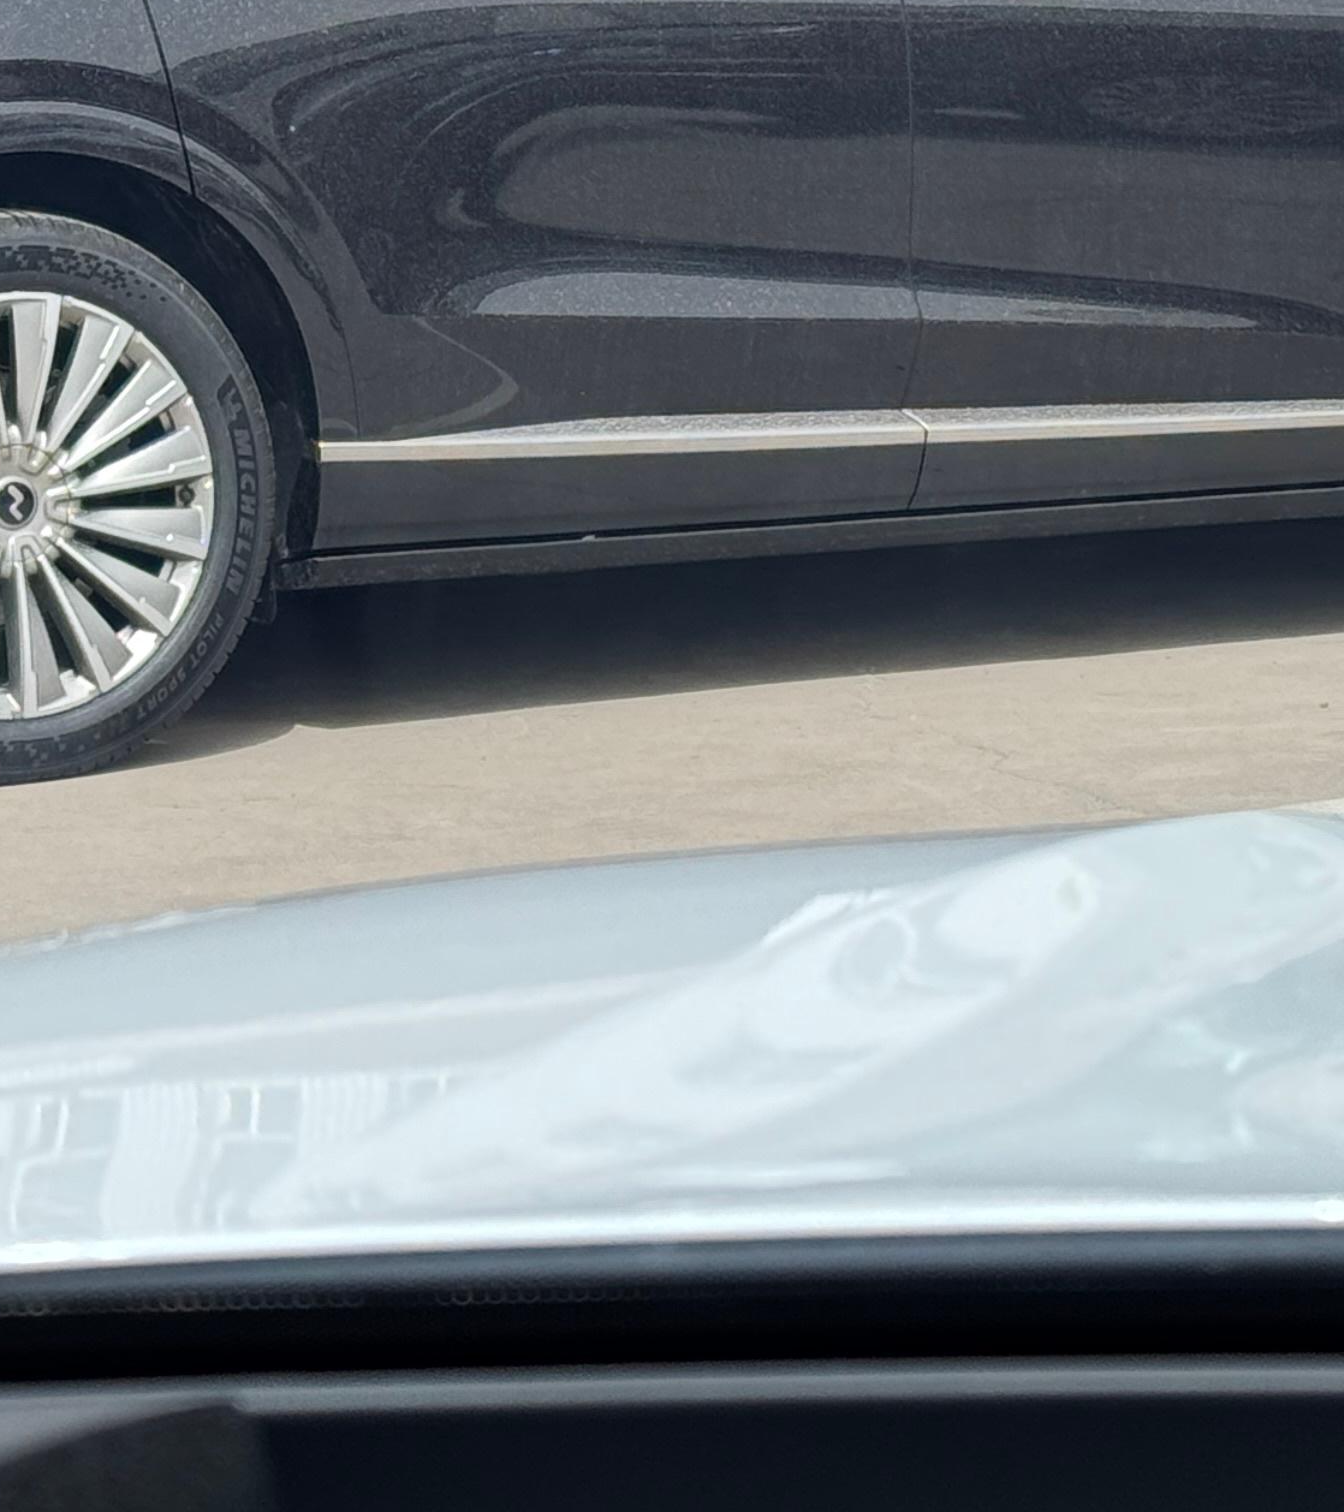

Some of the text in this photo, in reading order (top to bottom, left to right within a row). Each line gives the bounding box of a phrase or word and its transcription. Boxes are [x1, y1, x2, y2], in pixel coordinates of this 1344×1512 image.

[225, 428, 256, 595] MICHELIN
[136, 613, 224, 719] PILOT SPORT
